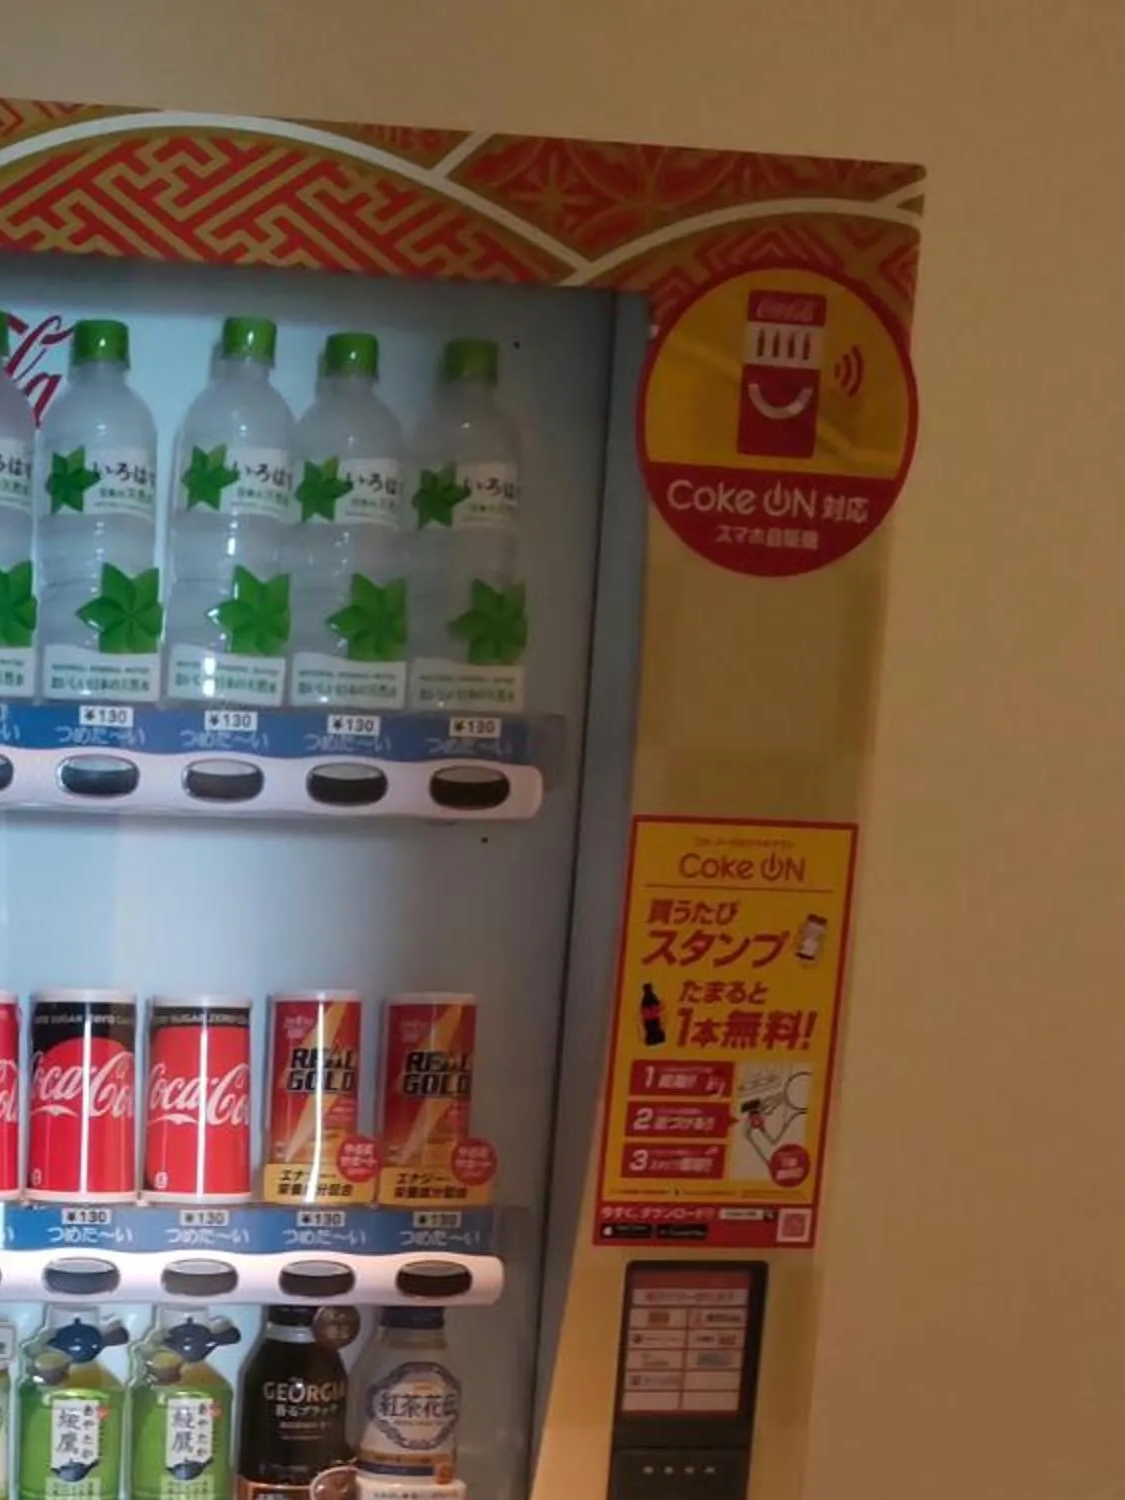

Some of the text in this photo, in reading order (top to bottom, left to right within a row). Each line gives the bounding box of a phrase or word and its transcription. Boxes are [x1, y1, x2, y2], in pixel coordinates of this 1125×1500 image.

[667, 480, 756, 515] Coke
[764, 480, 816, 518] ON
[83, 709, 128, 723] ¥130
[208, 714, 253, 728] ¥130
[331, 719, 375, 733] ¥130
[679, 851, 806, 883] Coke ON
[647, 898, 741, 925] 買うたび
[641, 929, 791, 968] スタンプ
[679, 979, 768, 1004] たまると
[287, 1070, 357, 1093] GOLD
[403, 1073, 471, 1096] GOLD
[633, 1107, 653, 1130] 2
[629, 1149, 648, 1171] 3
[65, 1210, 107, 1224] ¥130
